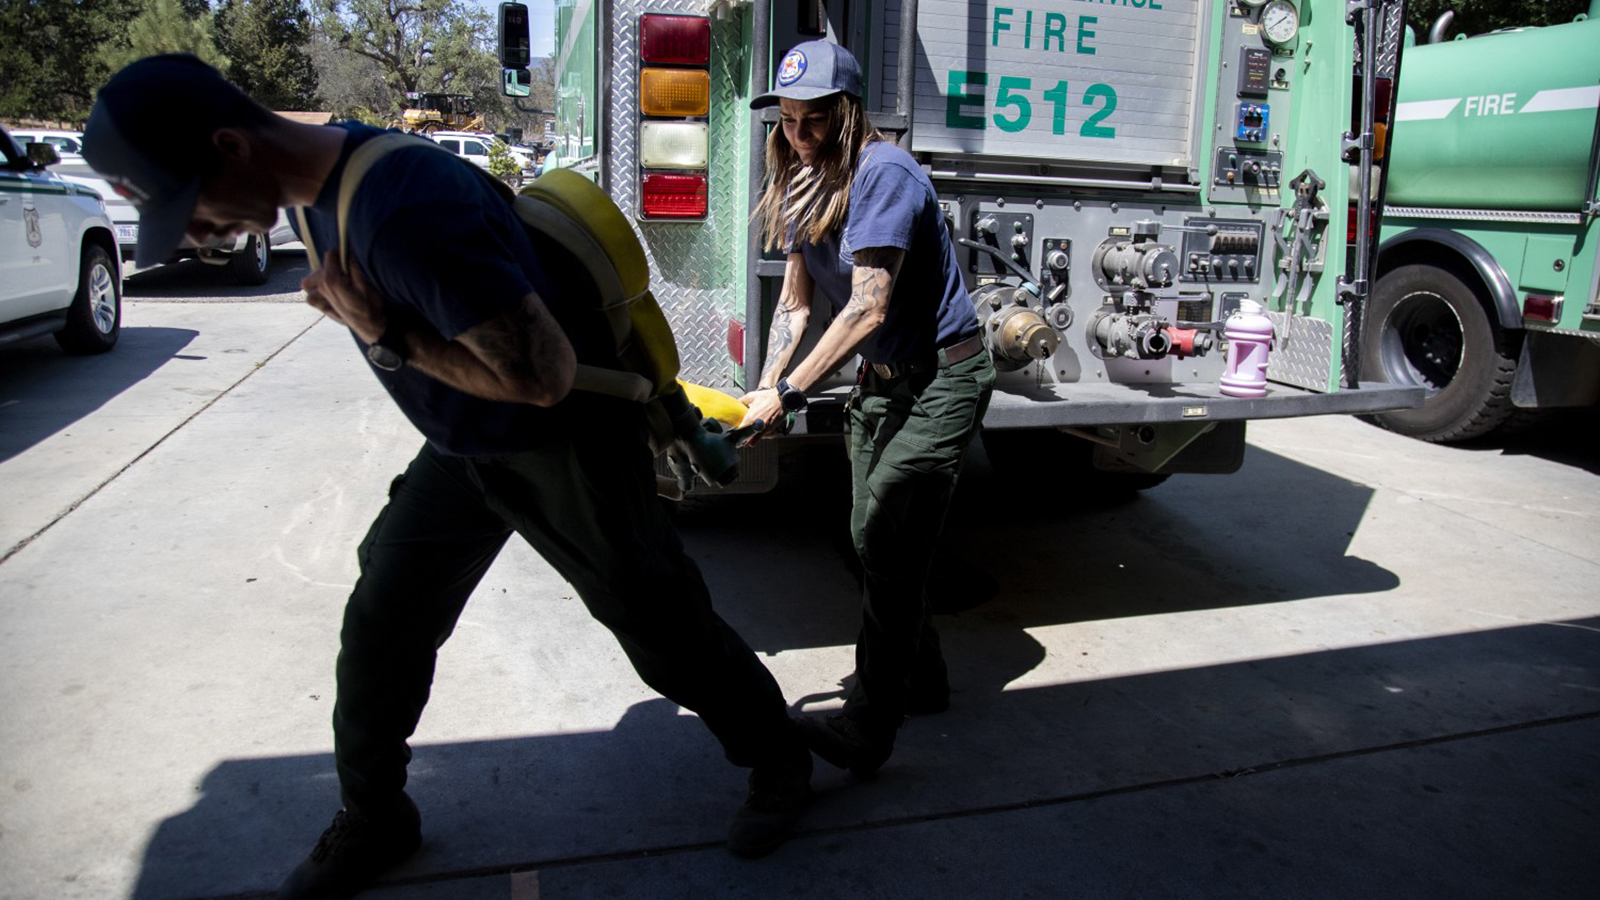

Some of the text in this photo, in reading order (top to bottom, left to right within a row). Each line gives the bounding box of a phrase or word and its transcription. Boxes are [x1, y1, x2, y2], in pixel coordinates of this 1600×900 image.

[992, 7, 1098, 55] FIRE
[946, 70, 1117, 139] E512
[1464, 92, 1517, 117] FIRE
